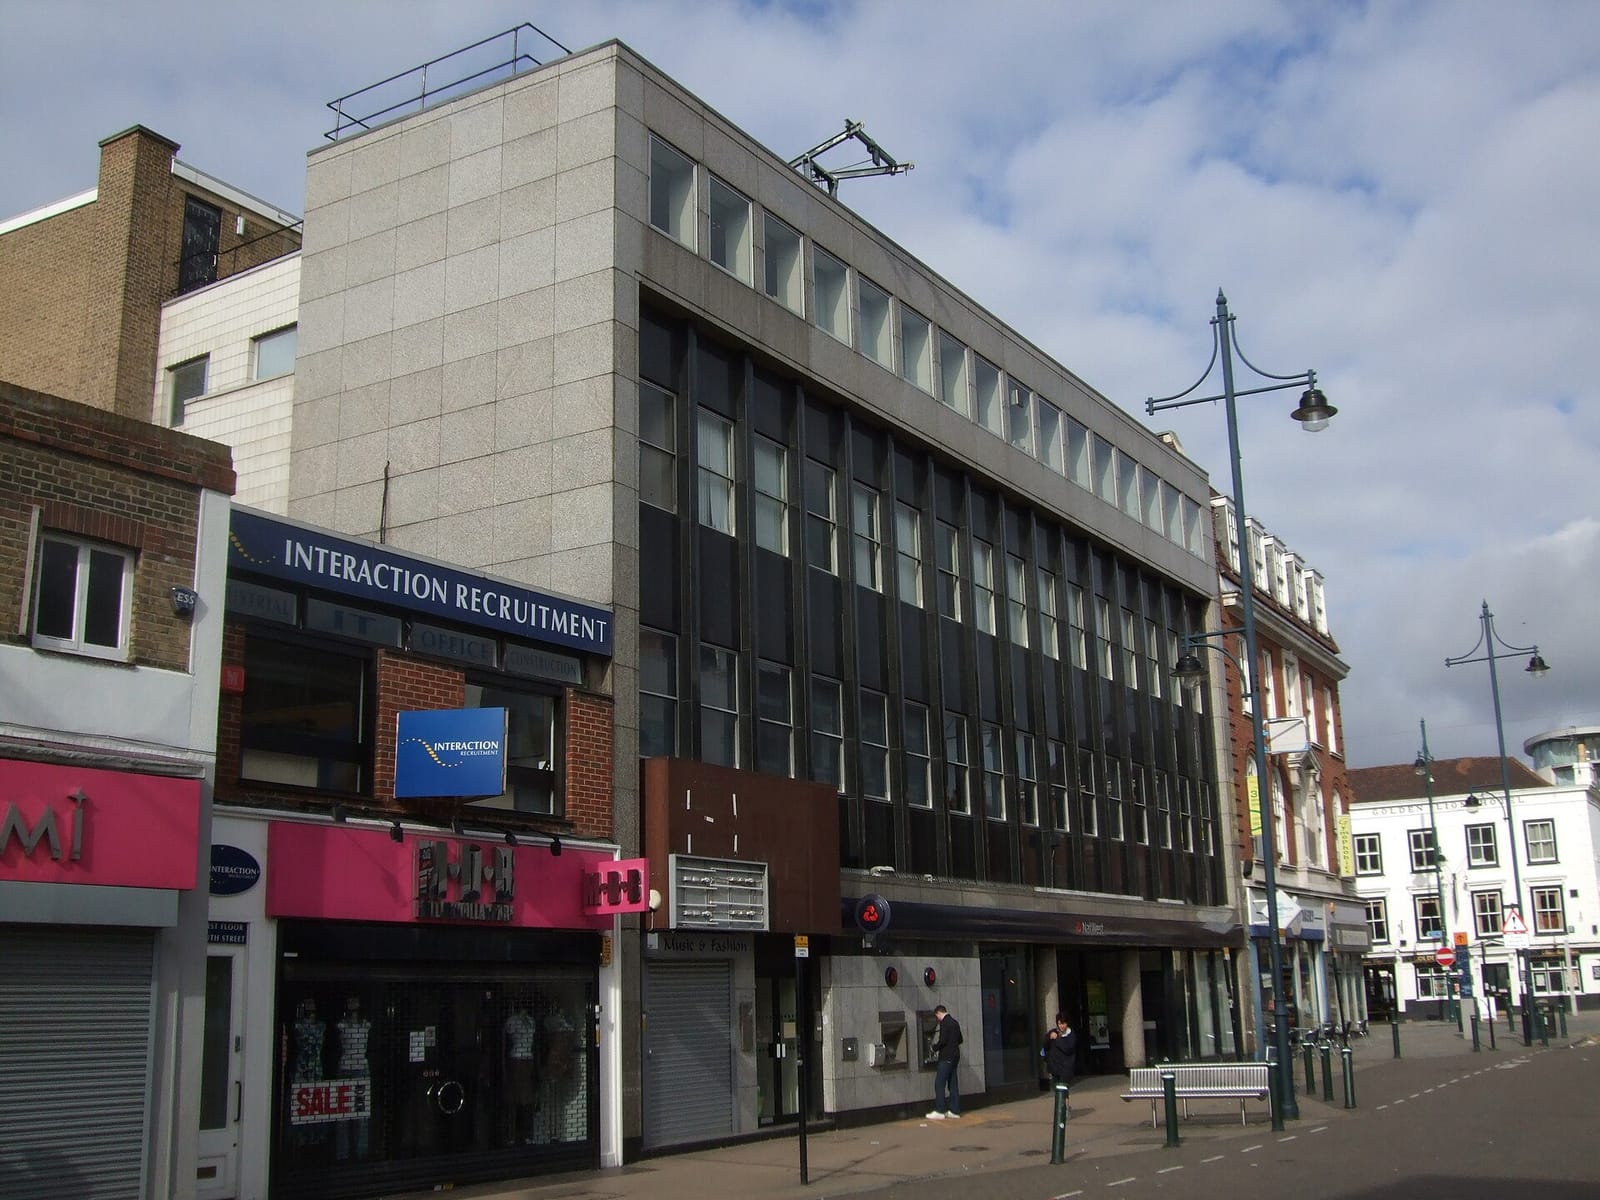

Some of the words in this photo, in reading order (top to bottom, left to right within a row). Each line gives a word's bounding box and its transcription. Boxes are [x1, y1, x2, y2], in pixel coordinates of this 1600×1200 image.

[284, 539, 447, 604] INTERACTION
[455, 583, 607, 643] RECRUITMENT
[177, 592, 195, 605] ESS
[421, 630, 489, 660] OFFICE
[434, 740, 499, 751] INTERACTION
[1372, 805, 1424, 816] GOLDEN
[220, 922, 244, 931] FLOOR
[221, 934, 246, 943] STREET
[663, 936, 694, 952] Music
[711, 936, 748, 953] Fashion
[296, 1085, 352, 1116] SALE
